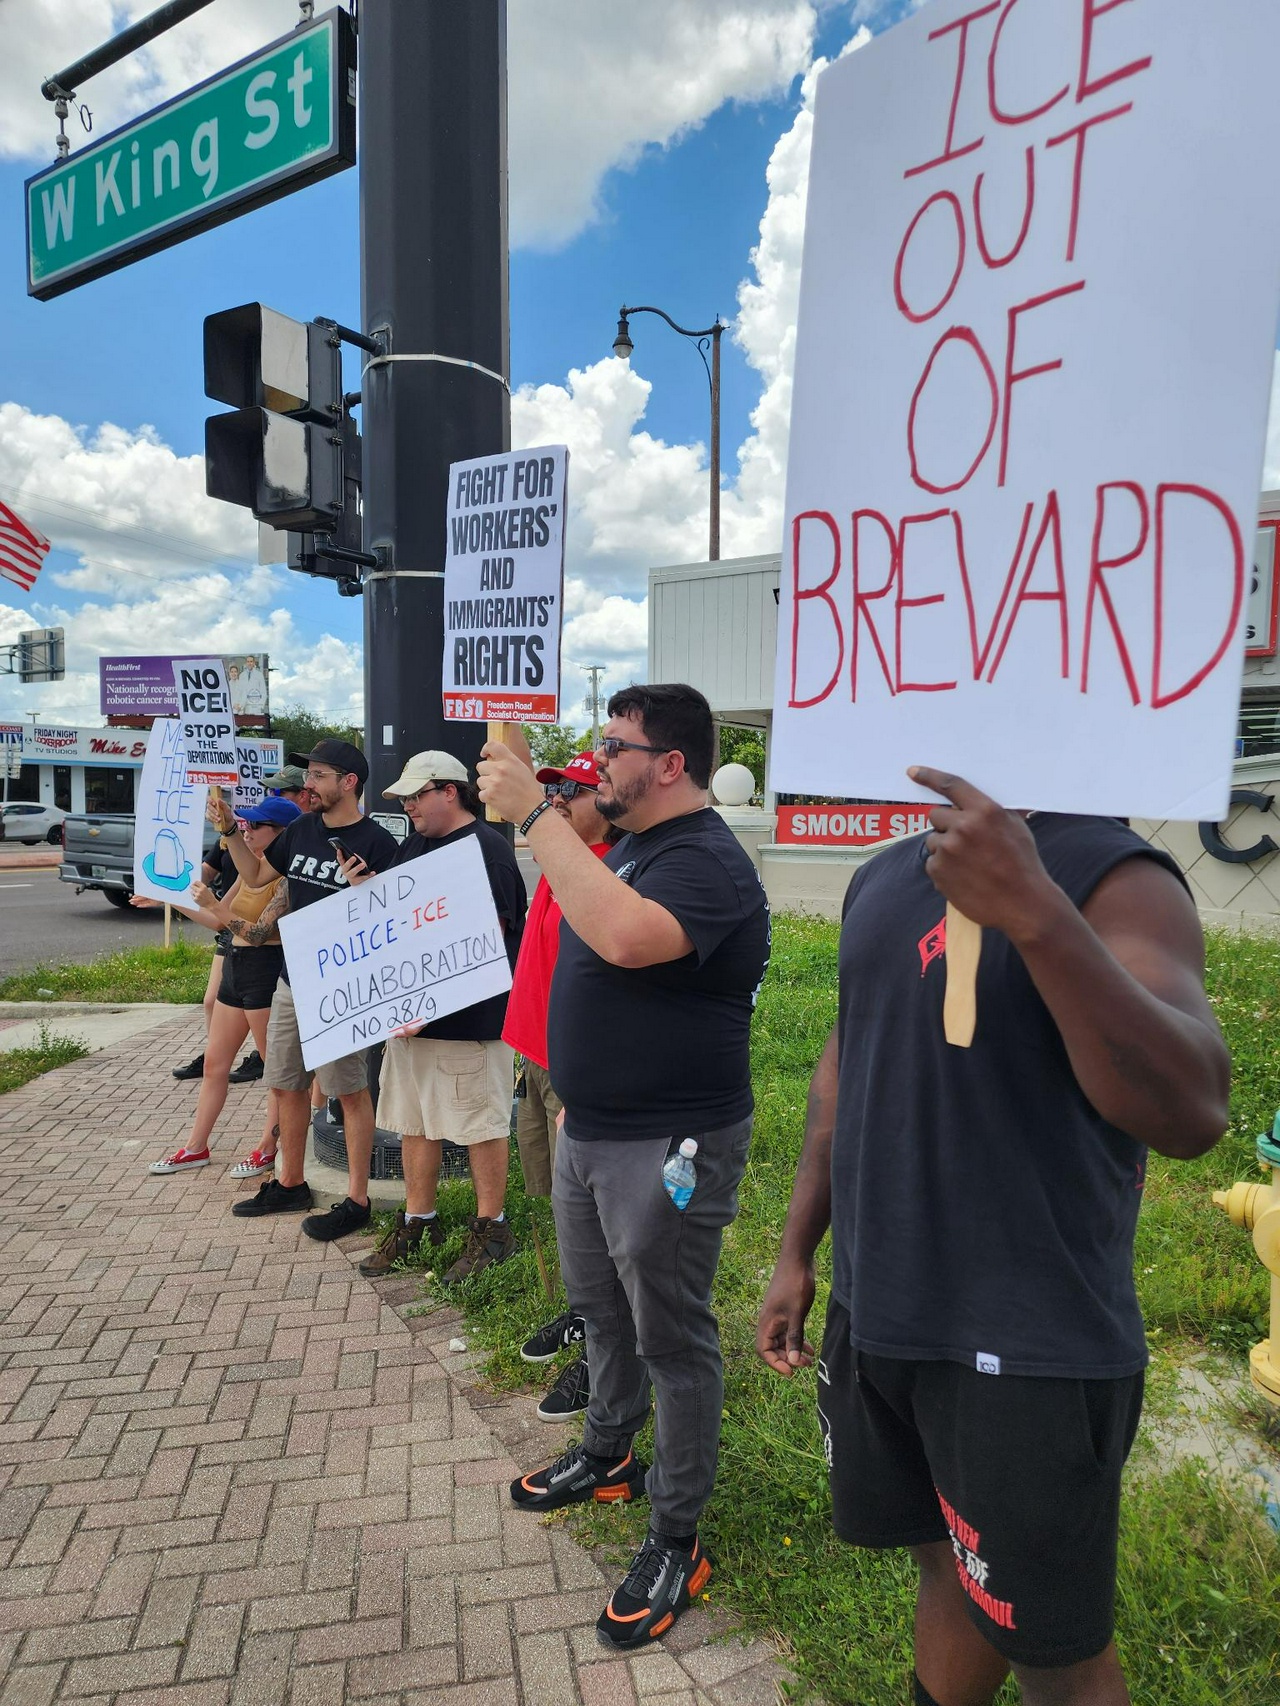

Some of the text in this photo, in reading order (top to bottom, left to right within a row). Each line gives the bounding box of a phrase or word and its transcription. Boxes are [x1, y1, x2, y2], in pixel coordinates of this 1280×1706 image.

[904, 0, 1152, 180] ICE
[41, 51, 313, 250] W King St
[894, 101, 1133, 324] OUT
[907, 279, 1086, 495] OF
[456, 456, 555, 510] FIGHT FOR
[451, 503, 558, 556] WORKERS'
[480, 556, 515, 592] AND
[788, 480, 1245, 709] BREVARD
[448, 595, 555, 631] IMMIGRANTS'
[453, 634, 545, 687] RIGHTS
[106, 683, 150, 697] Nationally
[180, 668, 220, 690] NO
[106, 694, 136, 705] robotic
[136, 695, 162, 705] cancer
[181, 692, 229, 713] ICE!
[445, 698, 484, 719] FRSO
[486, 700, 533, 710] Freedom Road
[486, 709, 555, 721] Socialist Organization
[34, 728, 78, 739] FRIDAY NIGHT
[184, 723, 231, 739] STOP
[90, 738, 127, 755] Mike
[187, 750, 235, 765] DEPORTATIONS
[196, 740, 218, 749] THE
[236, 747, 258, 764] NO
[235, 786, 263, 797] STOP
[152, 790, 194, 825] ICE
[790, 813, 881, 837] SMOKE
[347, 875, 416, 924] END
[317, 896, 450, 979] POLICE-ICE
[319, 928, 498, 1024] COLLABORATION
[352, 1016, 382, 1044] NO
